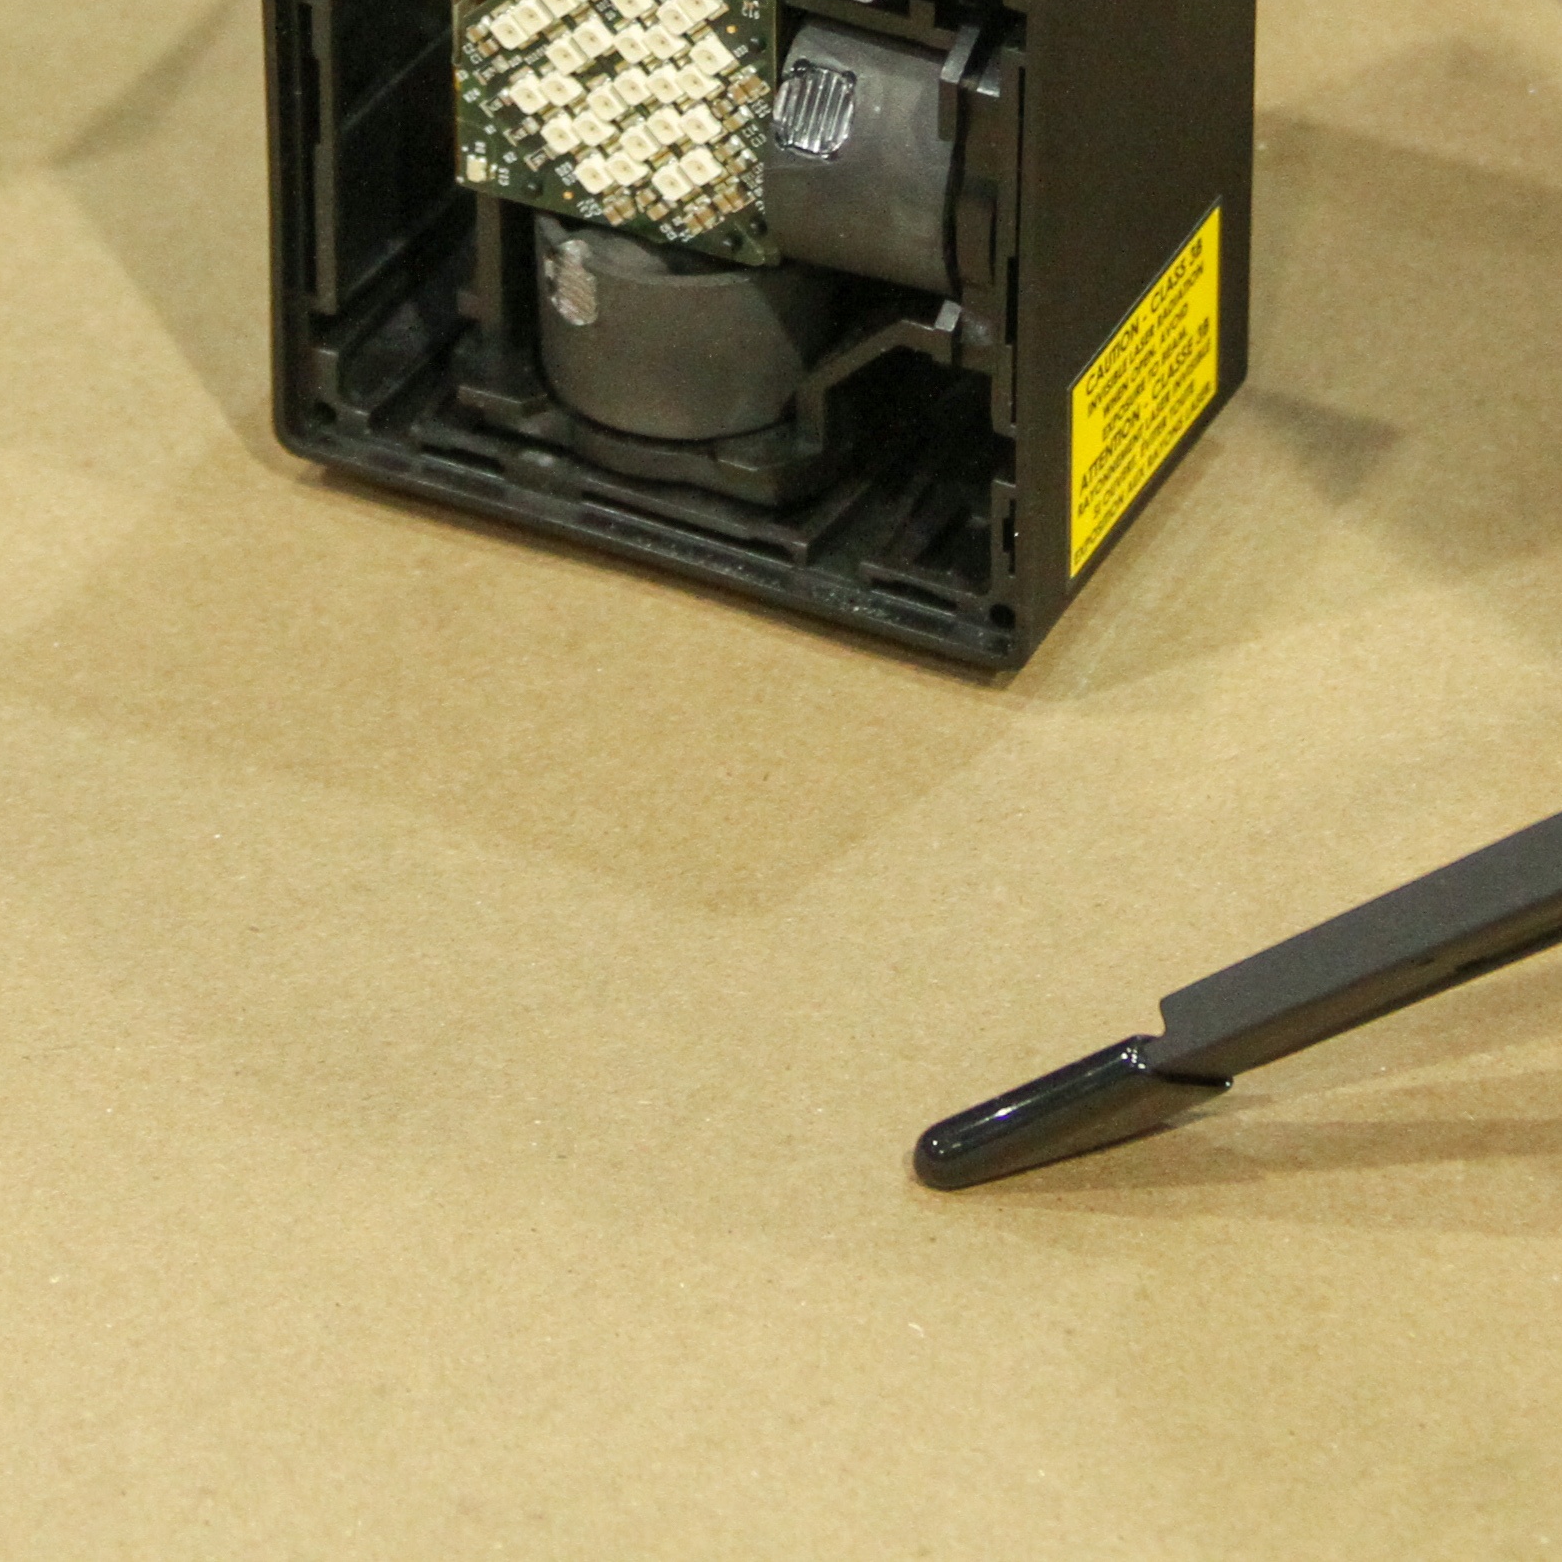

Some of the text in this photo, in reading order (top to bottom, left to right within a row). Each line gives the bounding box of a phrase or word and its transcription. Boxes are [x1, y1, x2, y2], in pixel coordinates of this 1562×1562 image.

[1086, 318, 1139, 396] CAUTION
[1150, 258, 1186, 314] CLASS
[1087, 359, 1127, 417] INVISIBLE
[1129, 324, 1155, 365] LASER
[1080, 408, 1140, 494] ATTENTION
[1151, 336, 1193, 401] CLASSE
